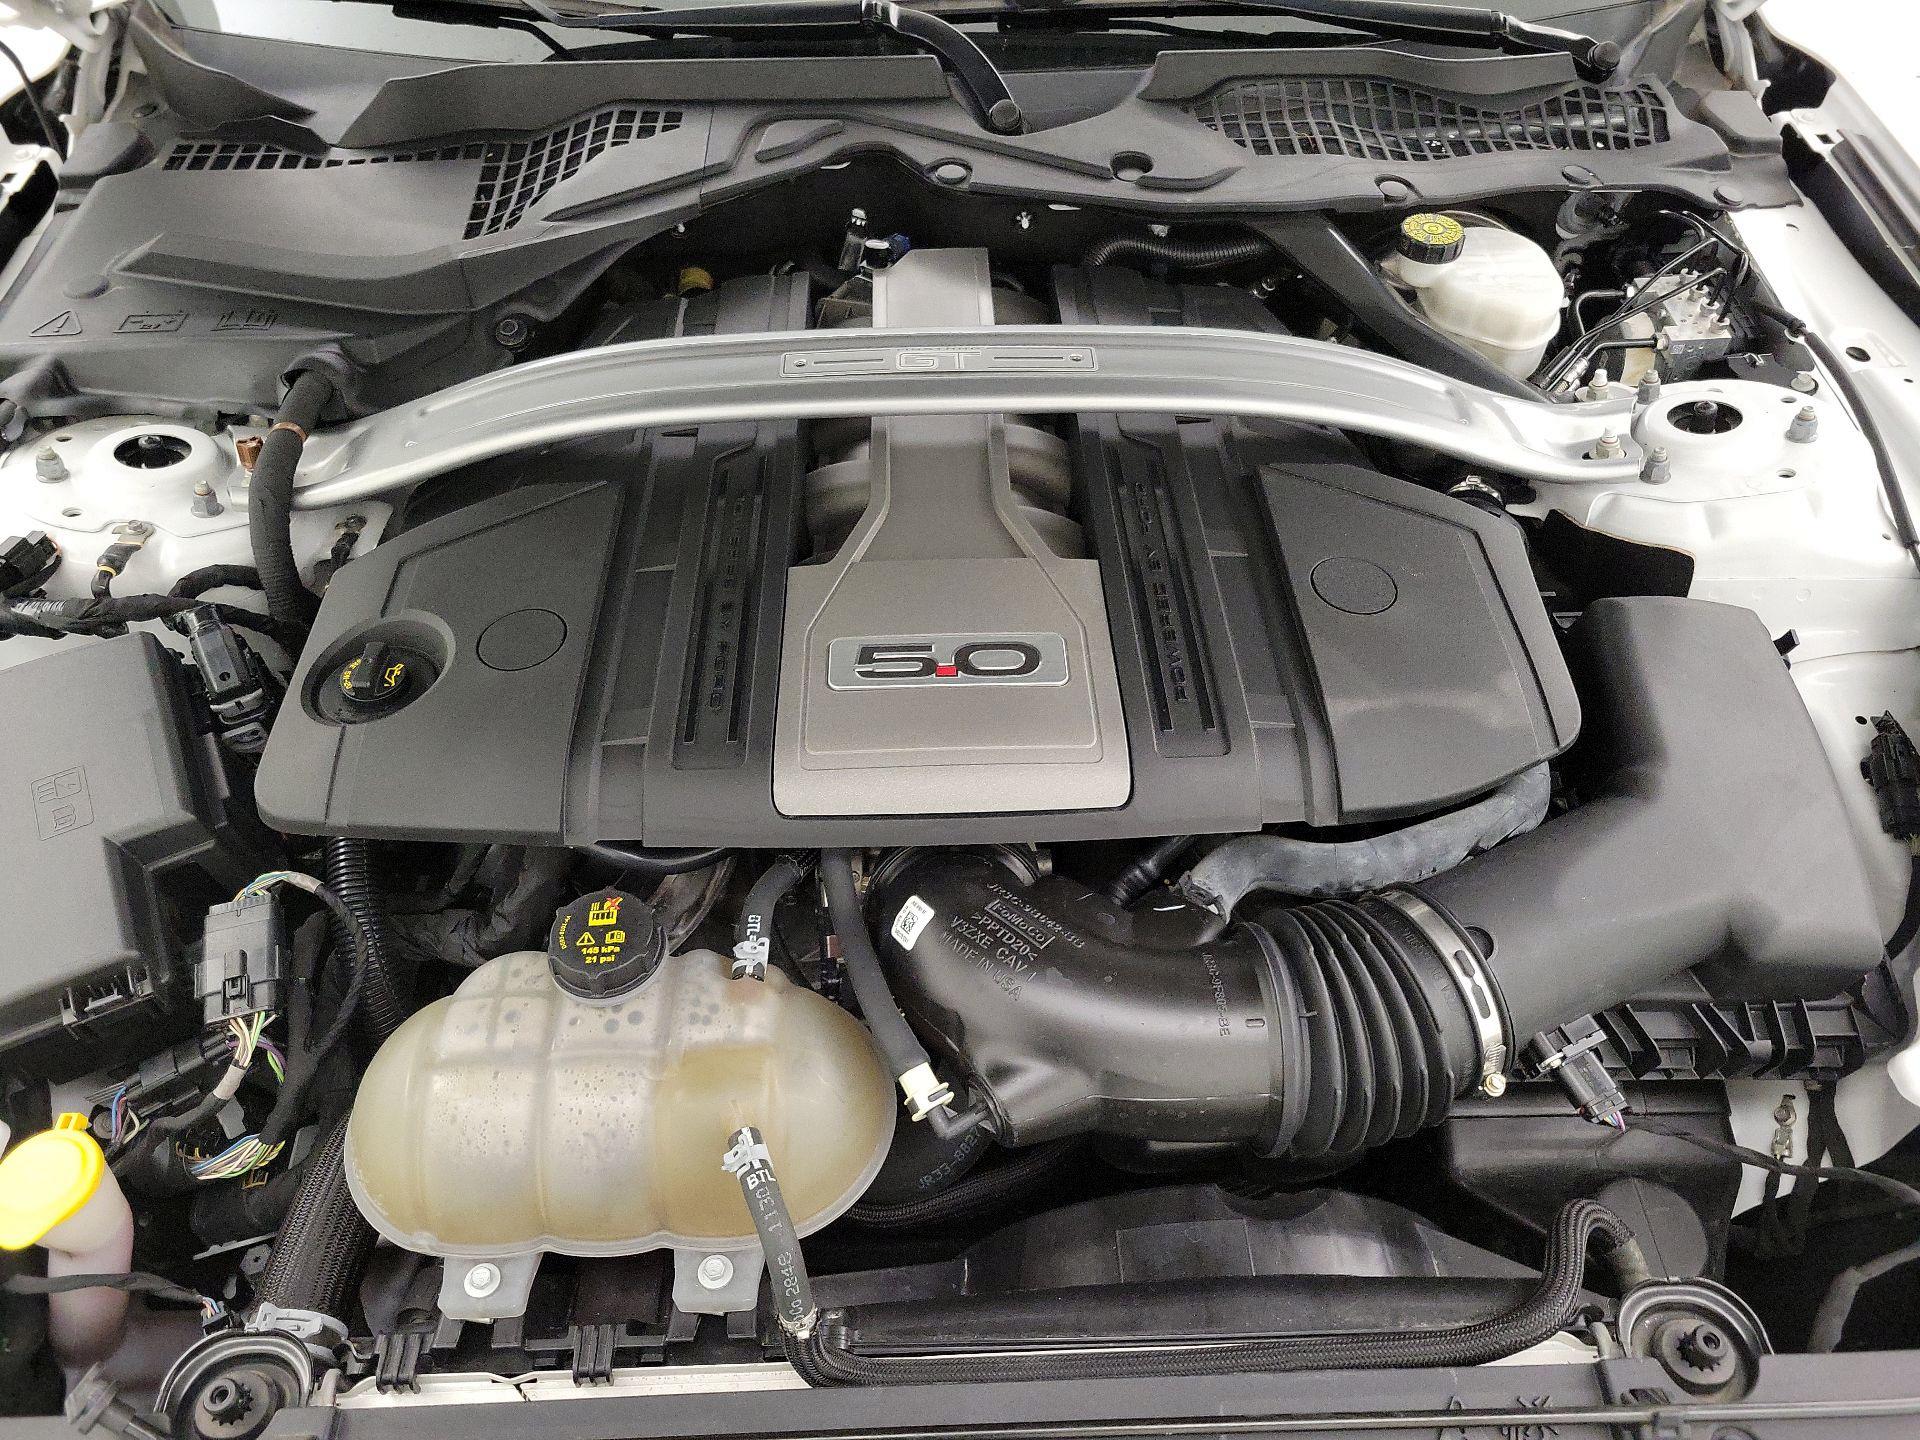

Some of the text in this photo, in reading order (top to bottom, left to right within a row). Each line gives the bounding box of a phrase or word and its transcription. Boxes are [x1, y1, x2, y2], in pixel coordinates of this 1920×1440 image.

[896, 350, 981, 371] GT
[854, 641, 1042, 679] 5.0
[1153, 582, 1188, 702] POWERED
[991, 903, 1045, 942] FoMoCo
[581, 945, 620, 955] 145 kPa
[585, 955, 615, 964] 21 psi
[950, 915, 994, 949] V3ZXE
[996, 947, 1028, 973] CAV
[940, 932, 979, 963] MADE
[976, 957, 994, 974] IN
[993, 969, 1023, 1000] USA
[746, 1169, 777, 1191] BTL
